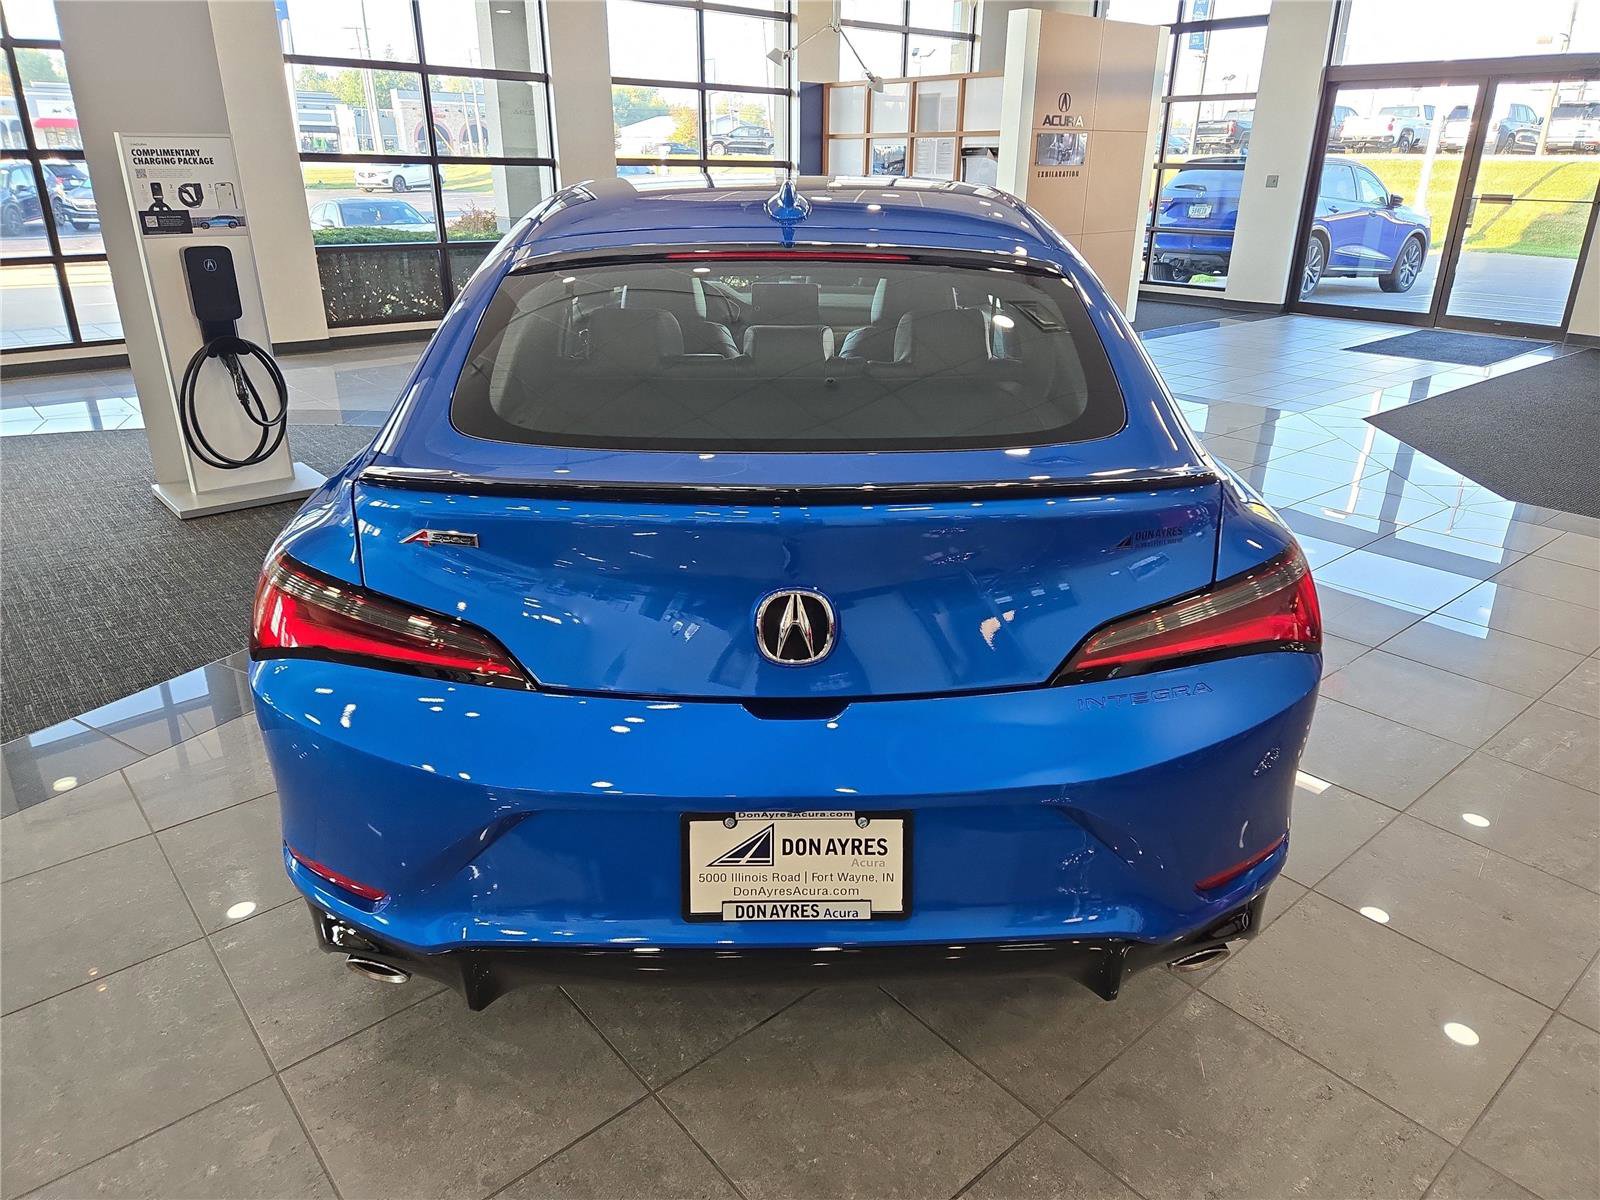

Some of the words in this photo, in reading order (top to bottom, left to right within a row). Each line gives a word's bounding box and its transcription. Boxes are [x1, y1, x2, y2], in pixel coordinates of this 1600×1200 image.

[1042, 114, 1084, 127] ACURA
[131, 148, 200, 157] COMPLIMENTARY
[133, 157, 176, 165] CHARGING
[177, 157, 215, 165] PACKAGE
[1077, 681, 1215, 711] INTEGRA
[737, 811, 853, 819] DonAyresAcura.com
[781, 838, 821, 856] DON
[825, 838, 888, 856] AYRES
[851, 858, 886, 868] Acura
[698, 873, 727, 882] 5000
[731, 873, 768, 882] Illinois
[772, 872, 800, 882] Road
[811, 872, 834, 882] Fort
[837, 872, 878, 883] Wayne,
[882, 872, 894, 882] IN
[733, 886, 859, 897] DonAyresAcura.com
[735, 904, 767, 918] DON
[769, 904, 820, 918] AYRES
[823, 908, 859, 918] Acura
